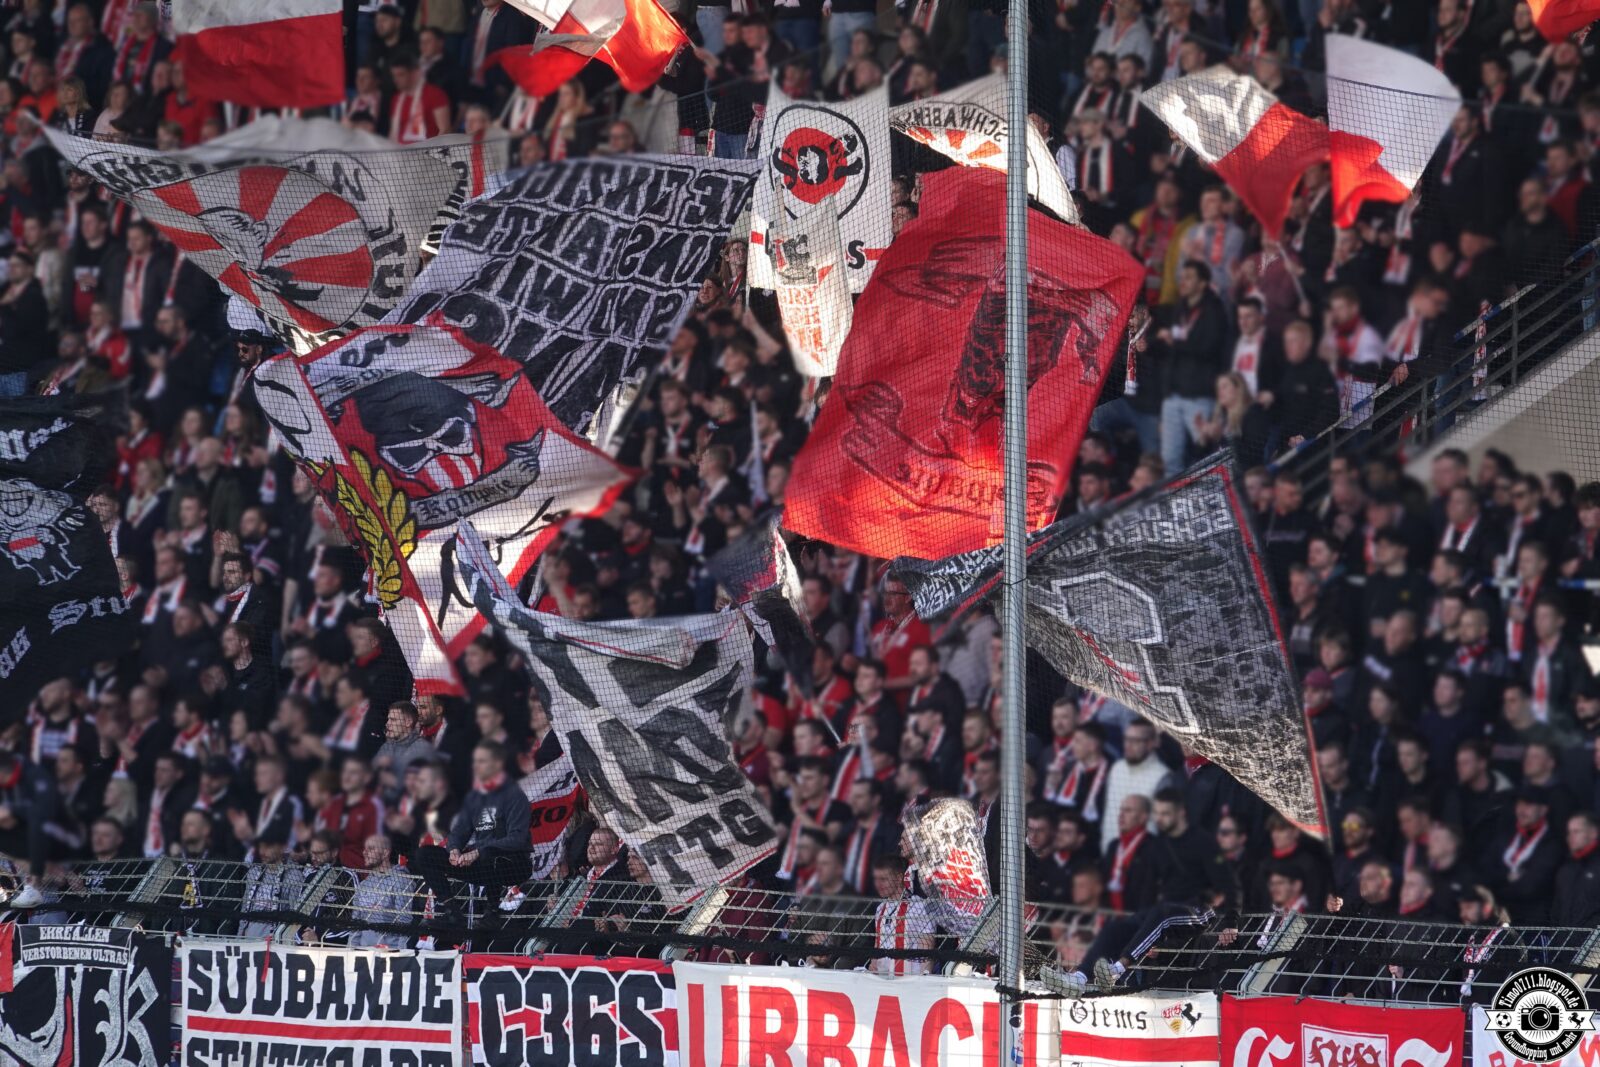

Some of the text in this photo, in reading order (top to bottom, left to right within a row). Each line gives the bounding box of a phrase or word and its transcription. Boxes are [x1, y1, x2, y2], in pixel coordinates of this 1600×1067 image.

[39, 926, 72, 941] EHRE
[23, 946, 129, 965] VERSTORBENEN ULTRAS
[186, 945, 454, 1024] SÜDBANDE
[1069, 1000, 1148, 1031] Glems
